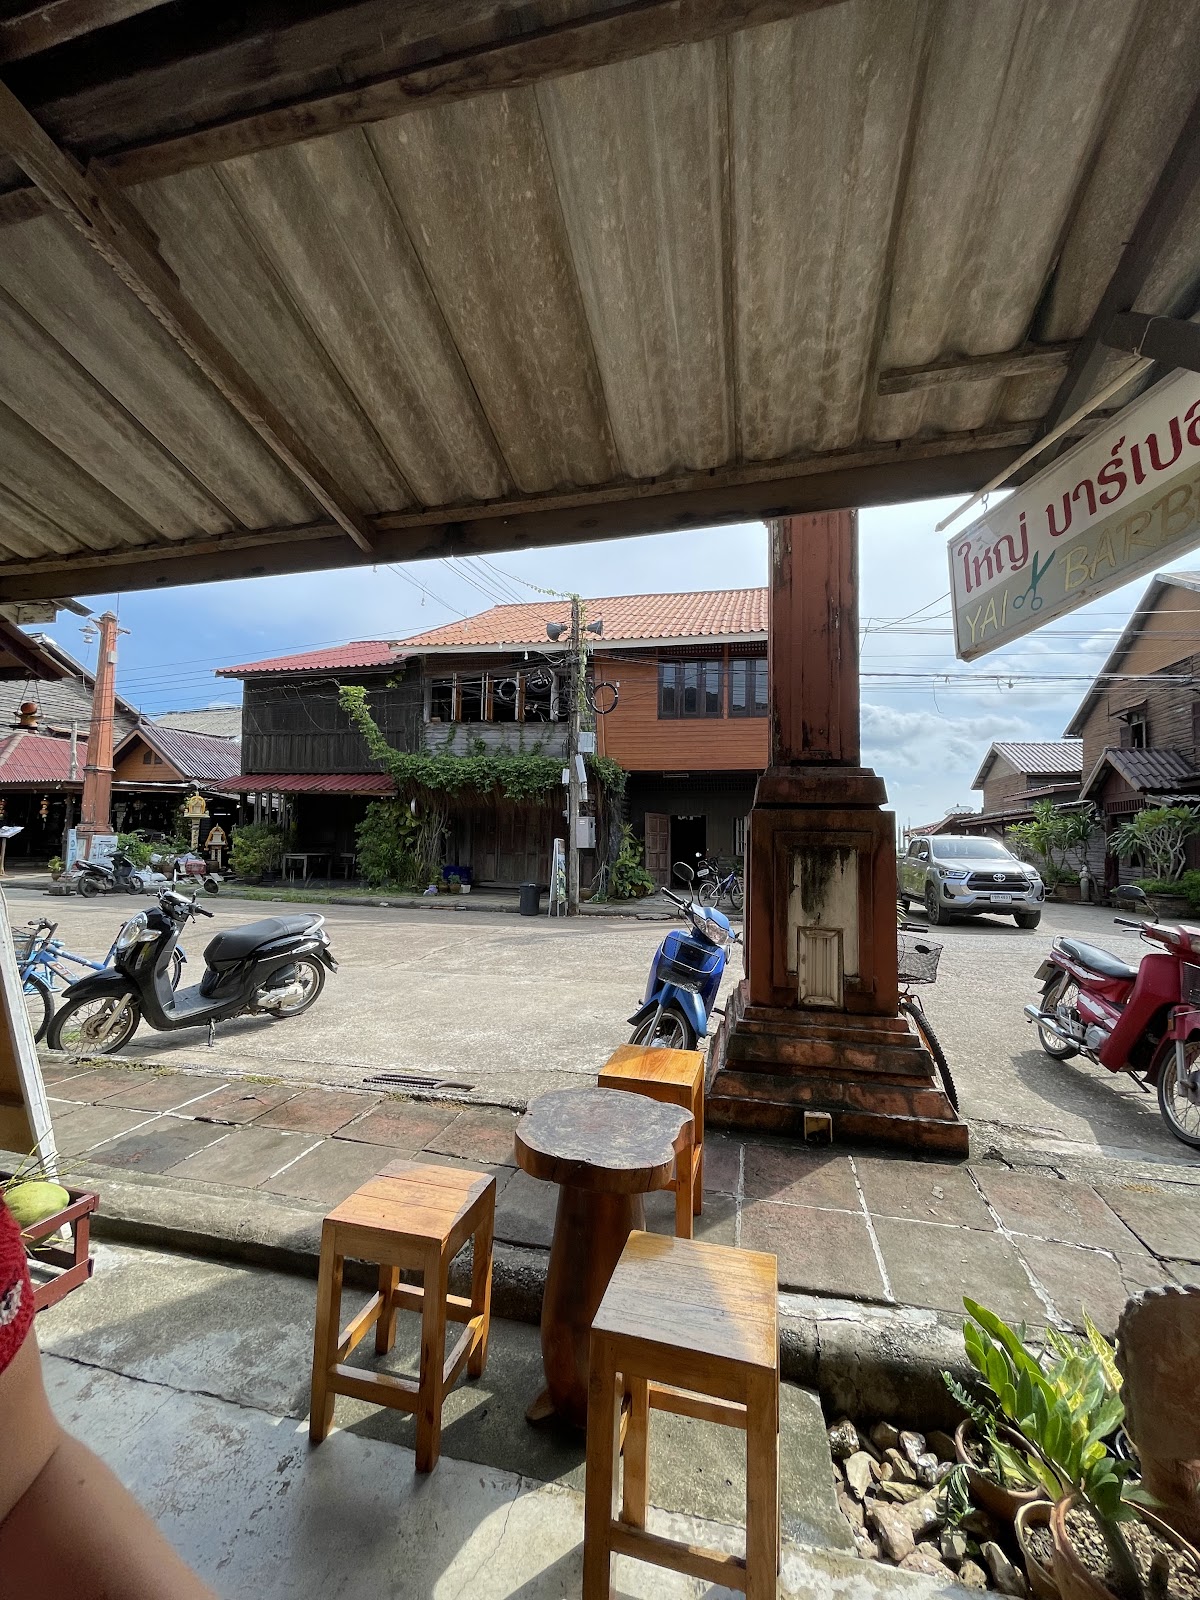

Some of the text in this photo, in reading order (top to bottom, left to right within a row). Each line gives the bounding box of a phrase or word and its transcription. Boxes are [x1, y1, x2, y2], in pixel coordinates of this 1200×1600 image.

[957, 511, 1029, 593] ใหญ่
[966, 475, 1200, 643] YAI BARB
